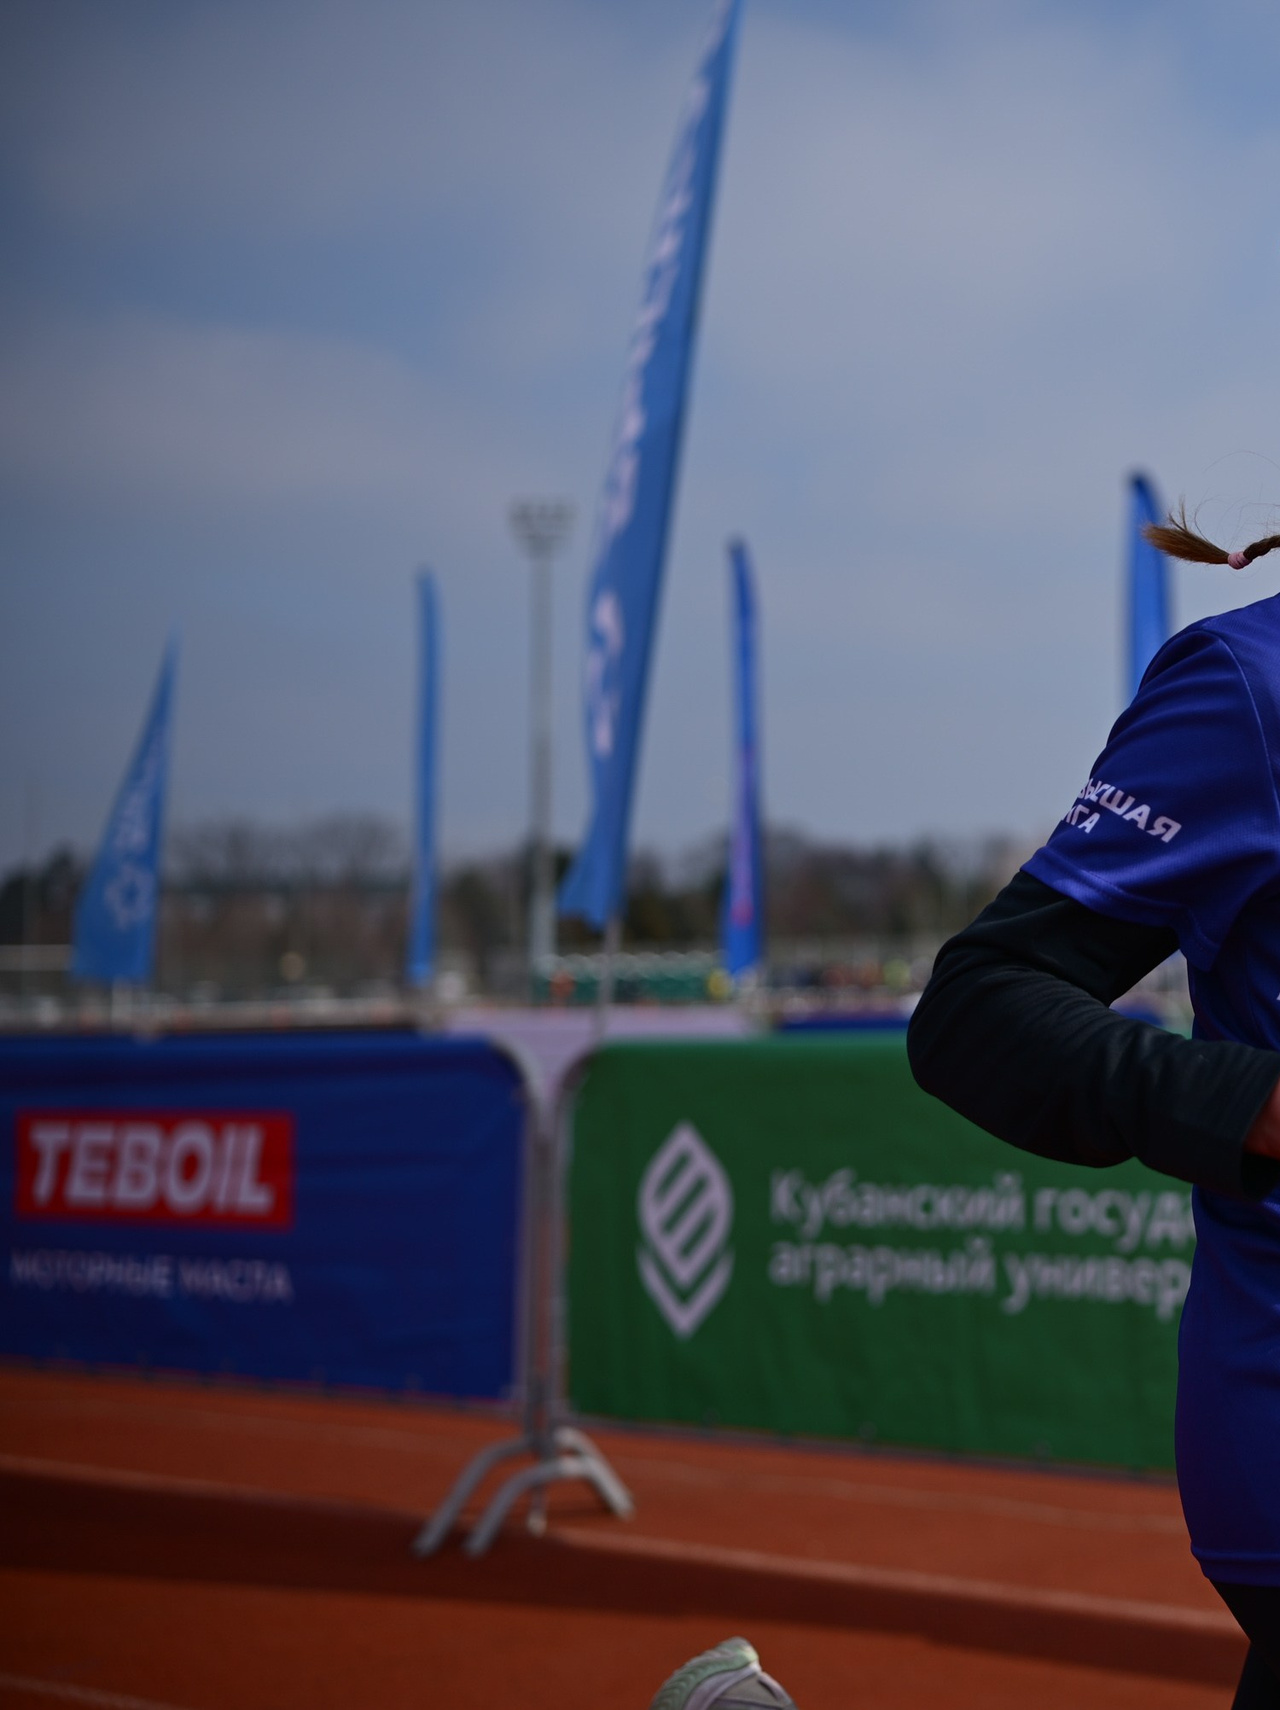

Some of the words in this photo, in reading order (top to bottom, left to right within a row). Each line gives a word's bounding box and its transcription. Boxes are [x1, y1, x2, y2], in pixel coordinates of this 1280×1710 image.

[28, 1119, 275, 1216] TEBOIL
[769, 1167, 1027, 1238] Кубанский
[1032, 1187, 1197, 1254] госуд
[767, 1234, 997, 1305] аграрный
